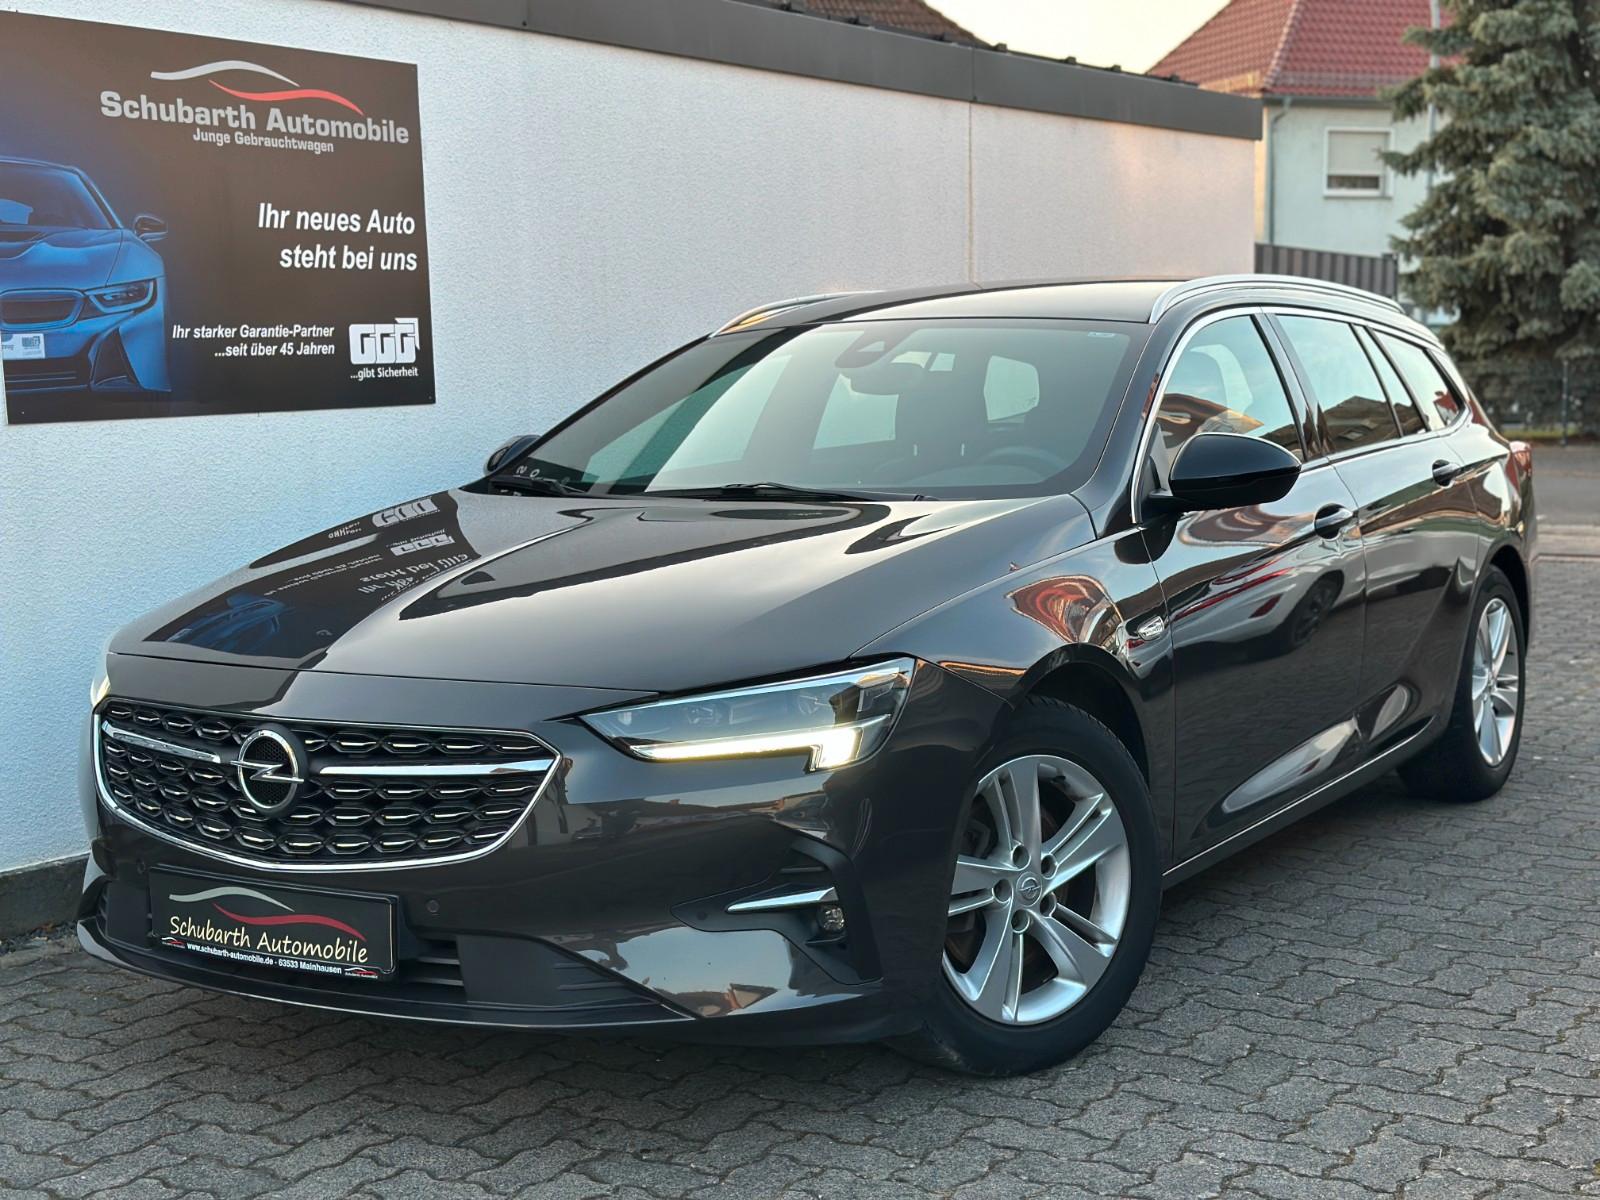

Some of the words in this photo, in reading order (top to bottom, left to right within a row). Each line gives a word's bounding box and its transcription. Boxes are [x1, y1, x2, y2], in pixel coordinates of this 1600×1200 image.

[100, 90, 256, 129] Schubarth
[266, 107, 409, 143] Automobile
[193, 128, 230, 146] Junge
[235, 131, 334, 154] Gebrauchtwagen
[258, 203, 290, 229] Ihr
[296, 210, 361, 232] neues
[366, 209, 415, 234] Auto
[280, 244, 336, 269] steht
[342, 245, 374, 270] bei
[380, 252, 417, 271] uns
[172, 325, 190, 338] Ihr
[193, 325, 237, 338] starker
[240, 324, 334, 338] Garantie-Partner
[214, 343, 248, 356] ...seit
[250, 343, 277, 355] über
[279, 343, 294, 355] 45
[296, 342, 335, 354] Jahren
[350, 367, 375, 381] ...gibt
[377, 366, 419, 377] Sicherheit
[170, 916, 251, 948] Schubarth
[256, 932, 368, 963] Automobile
[187, 943, 273, 965] www.schubarth-automobile.de
[278, 959, 298, 969] 63533
[300, 961, 342, 974] Mainhausen
